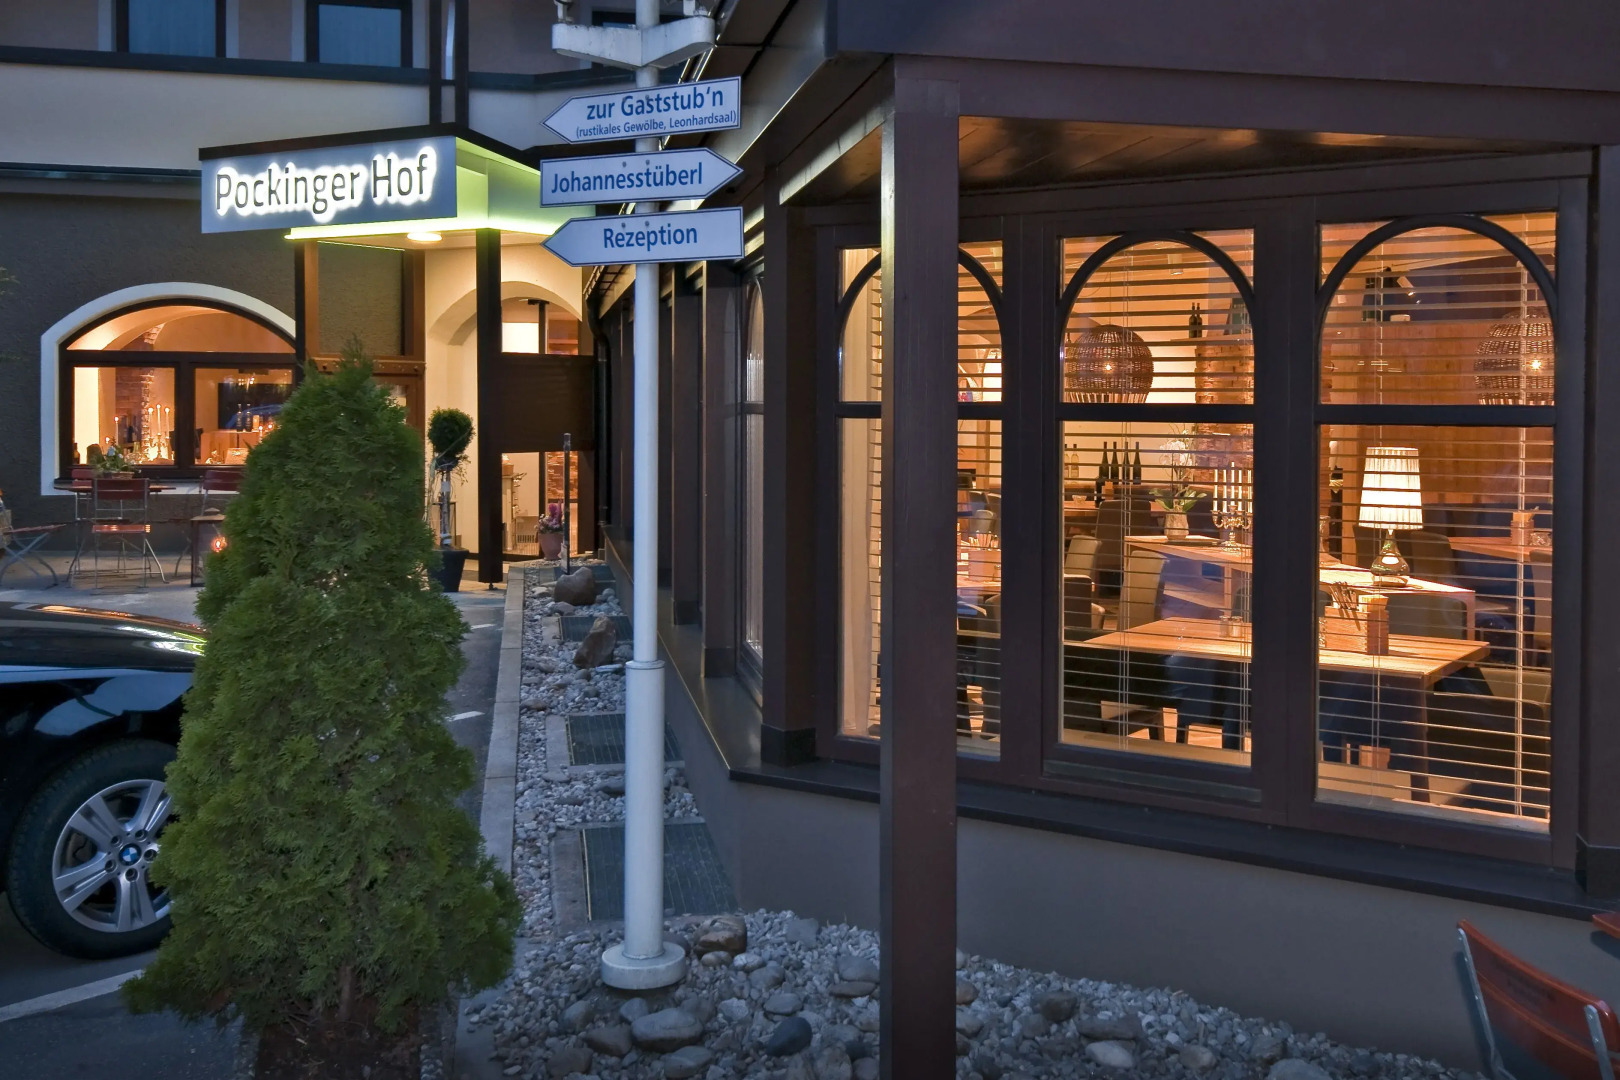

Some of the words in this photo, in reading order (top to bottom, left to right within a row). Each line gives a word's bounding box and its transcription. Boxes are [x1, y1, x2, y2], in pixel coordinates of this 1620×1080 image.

[576, 121, 621, 139] (rustikales
[623, 116, 667, 133] Gewölbe,
[669, 110, 737, 128] Leonhardsaal)
[586, 102, 616, 120] zur
[216, 166, 361, 215] Pockinger
[372, 153, 428, 199] Hof
[551, 162, 703, 193] Johannesstüberl
[603, 223, 698, 251] Rezeption
